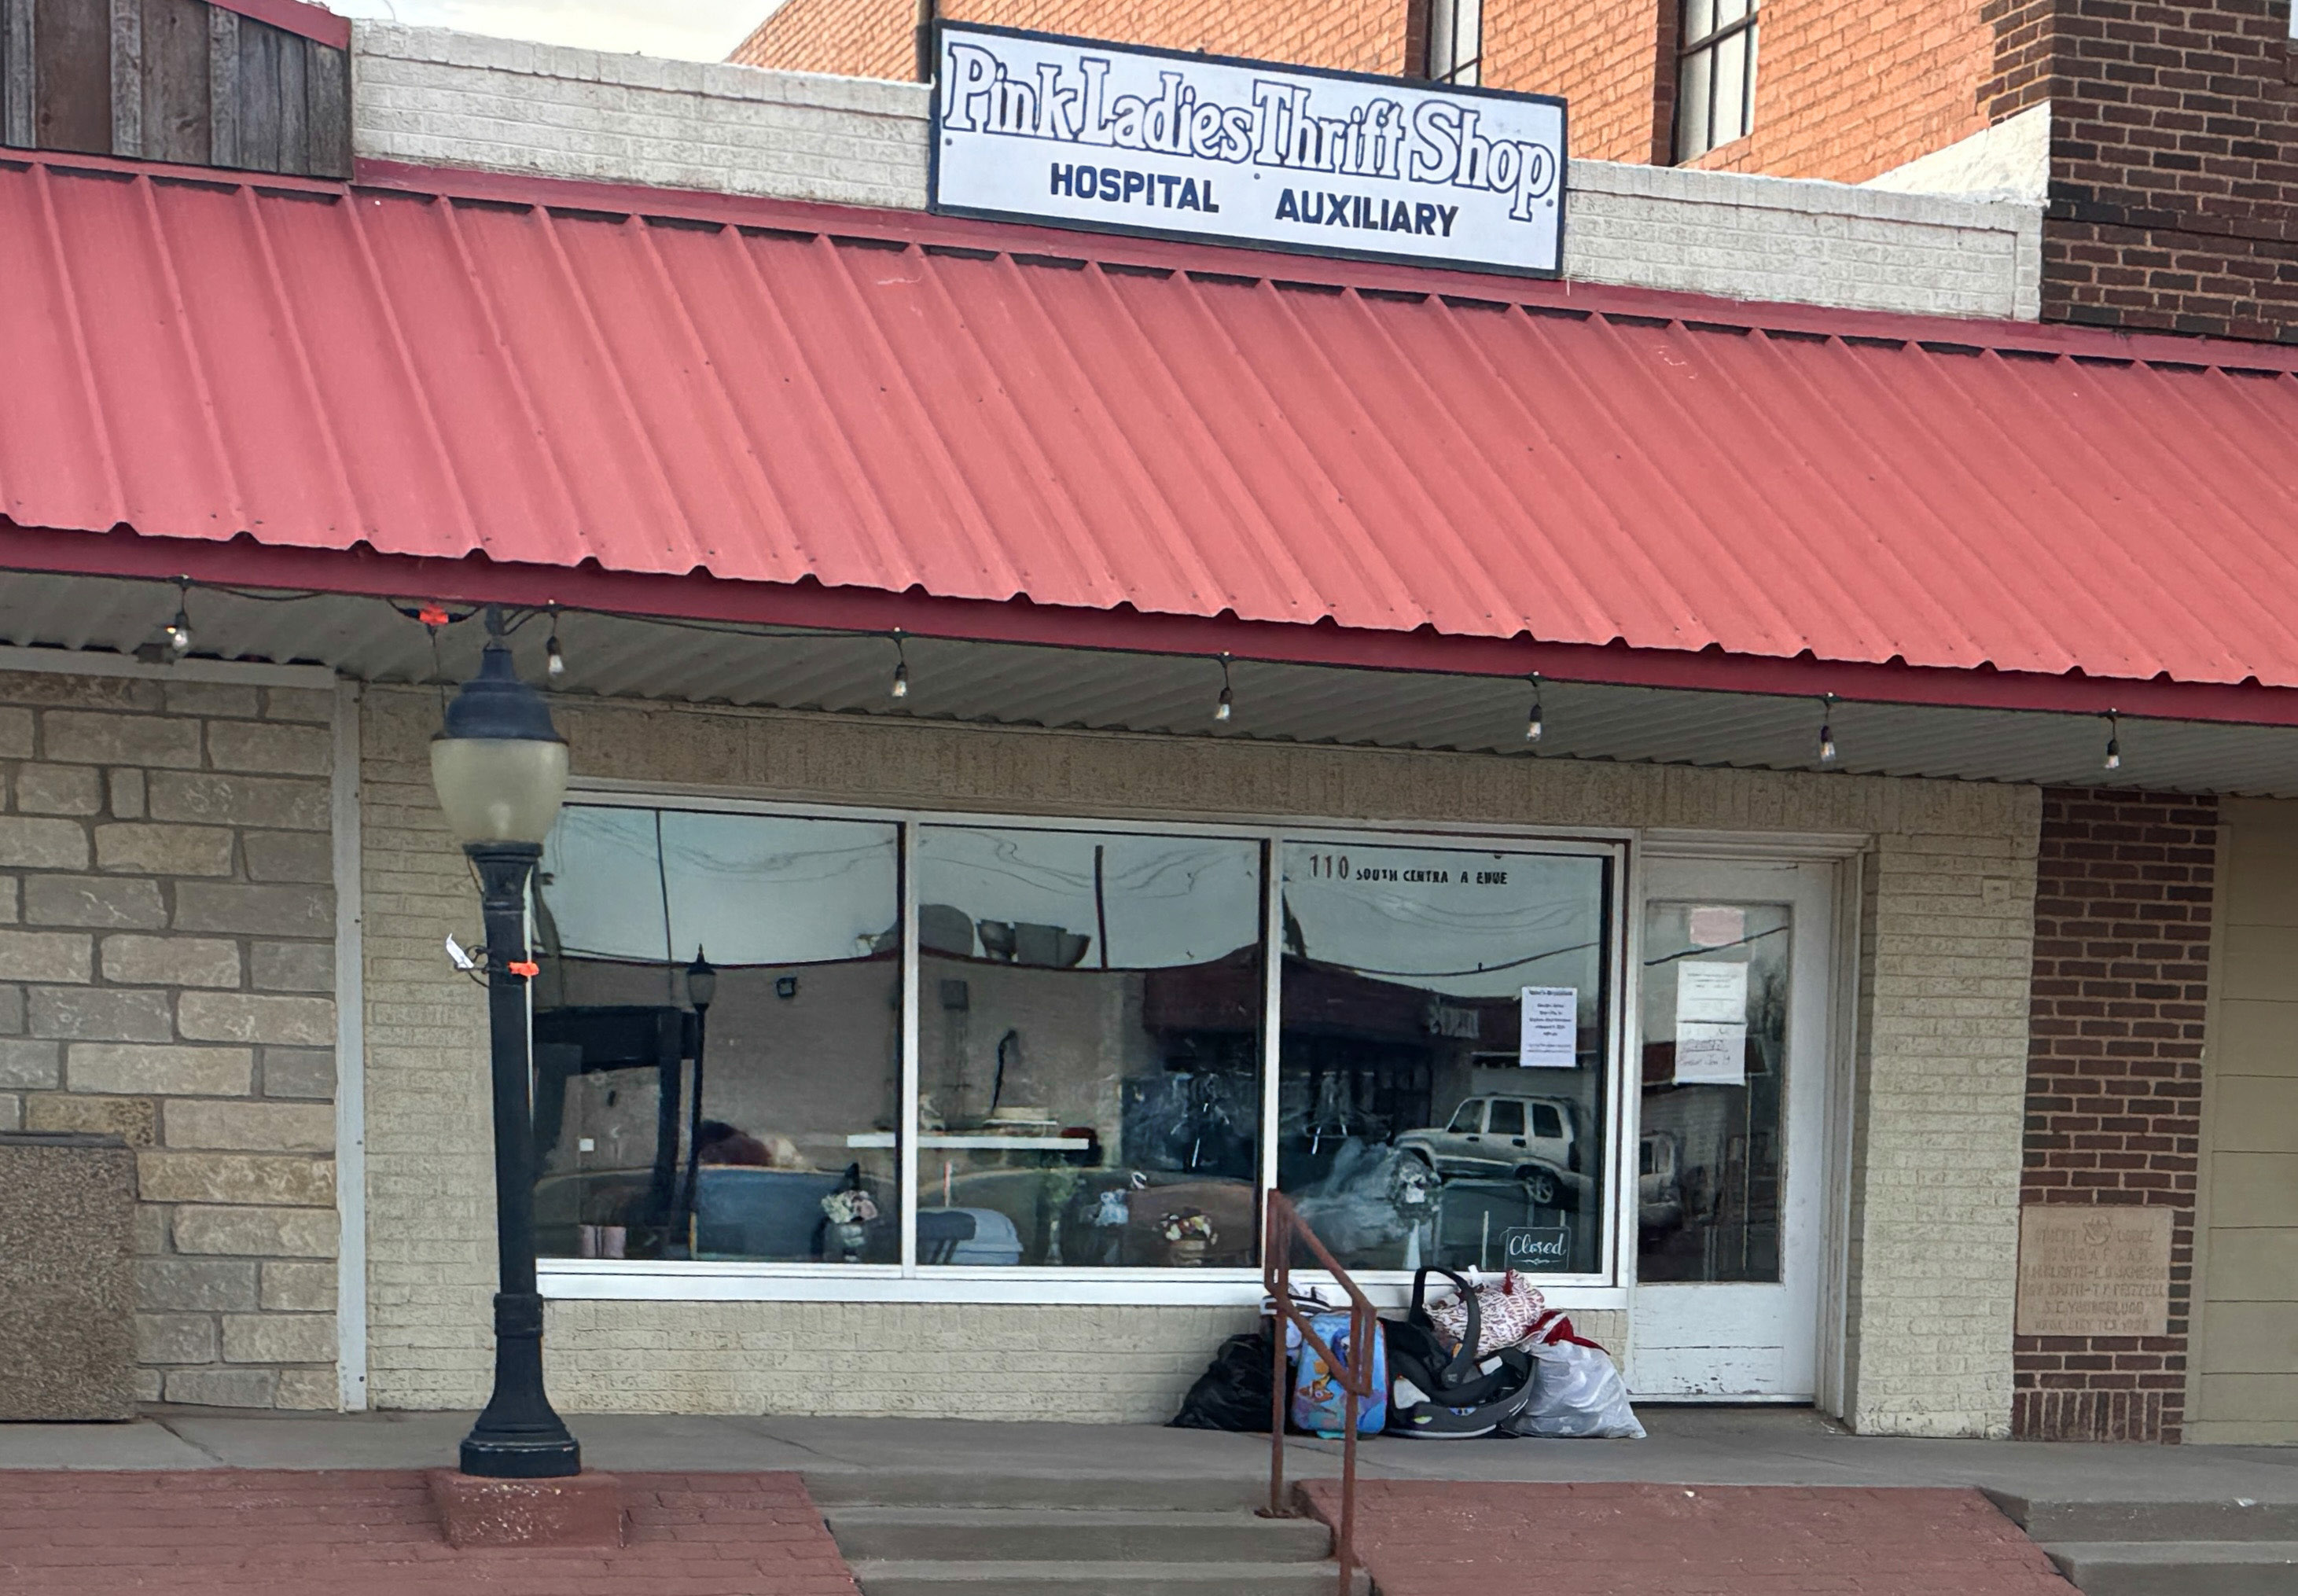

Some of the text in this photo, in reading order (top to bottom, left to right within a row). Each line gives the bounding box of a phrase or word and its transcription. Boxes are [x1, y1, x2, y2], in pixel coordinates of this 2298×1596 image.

[943, 42, 1555, 222] Pink Ladies Thrift Shop
[1050, 162, 1459, 237] HOSPITAL AUXILIARY
[1310, 854, 1349, 879] 110
[1356, 868, 1398, 881] SOUTH
[1403, 870, 1448, 883] CENTRA
[1509, 1234, 1567, 1256] Closed
